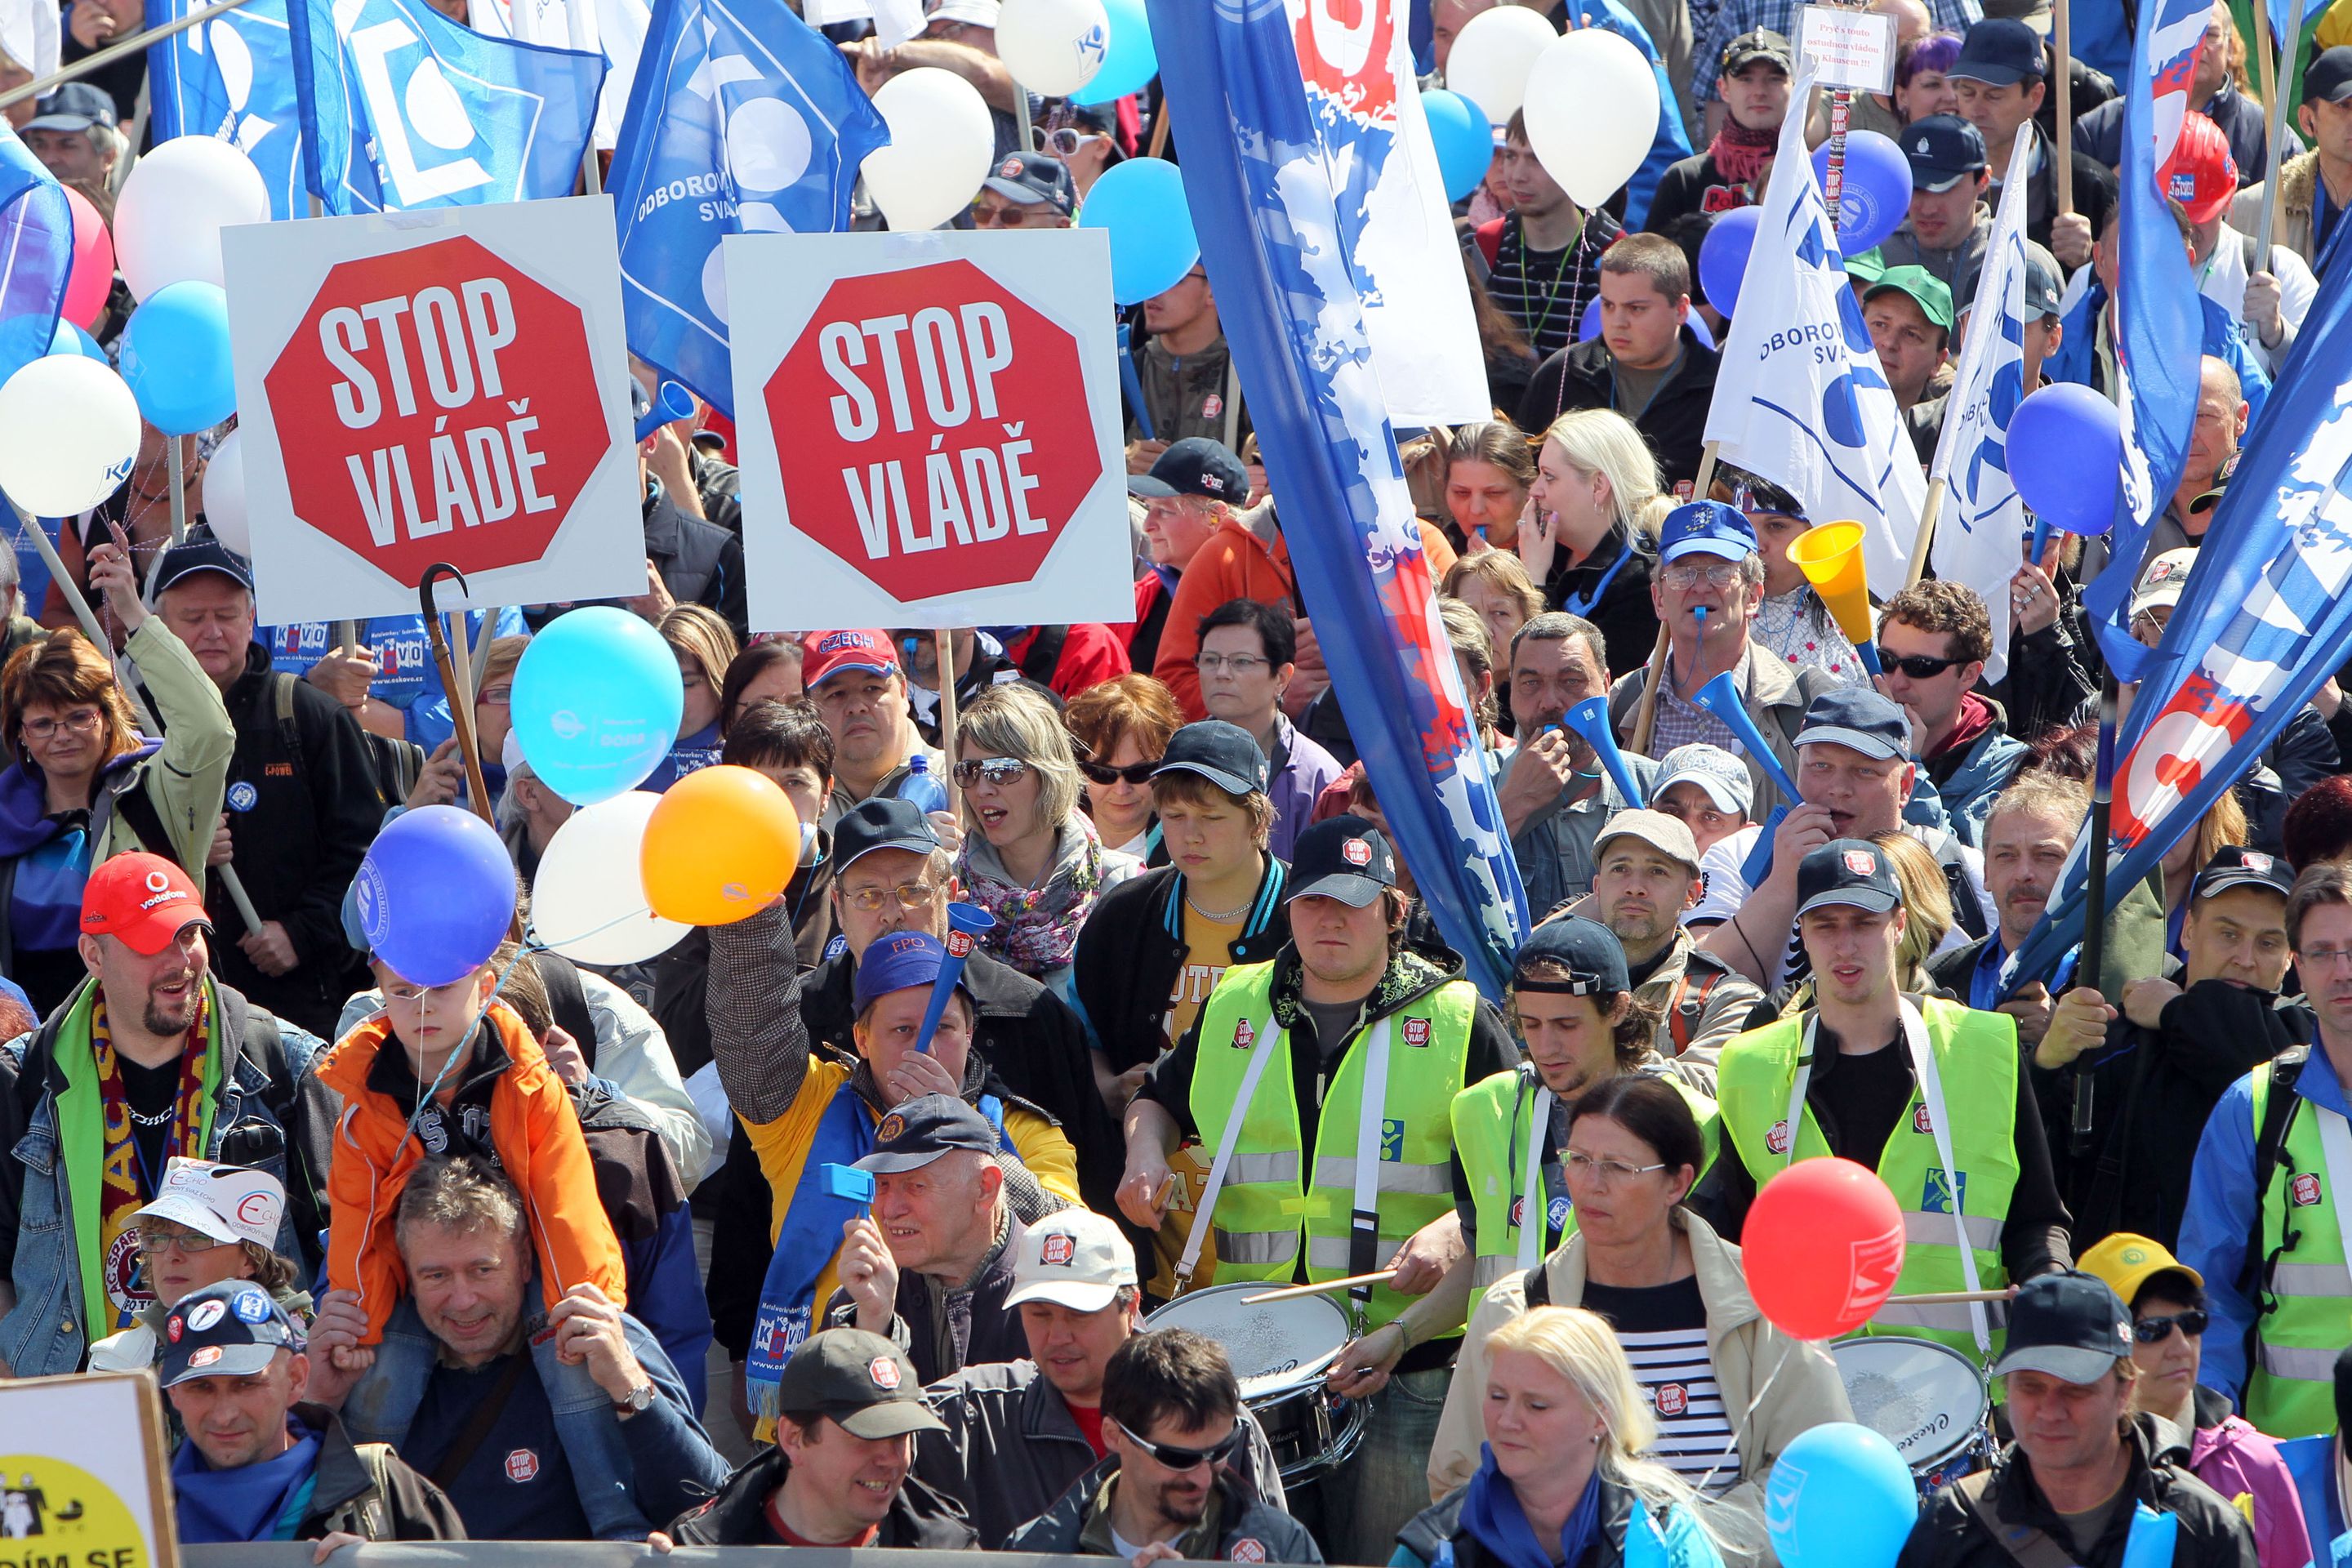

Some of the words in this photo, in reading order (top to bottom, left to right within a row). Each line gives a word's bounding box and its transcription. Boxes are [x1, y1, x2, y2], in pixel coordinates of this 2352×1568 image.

[1820, 23, 1839, 34] Pryč
[1847, 28, 1870, 38] touto
[1807, 38, 1848, 49] ostudnou
[1851, 43, 1880, 54] vládou
[1822, 54, 1858, 66] Klausem
[639, 170, 733, 223] ODBOROV
[699, 196, 738, 221] SVA
[318, 276, 516, 430] STOP
[818, 301, 1013, 443] STOP
[346, 397, 557, 548] VLÁDĚ
[842, 421, 1049, 560] VLÁDĚ
[819, 632, 875, 653] CZECH
[373, 645, 421, 670] KOVO
[371, 677, 423, 685] www.oskovo.cz
[1348, 842, 1365, 853] STOP
[140, 889, 188, 911] vodafone
[892, 938, 925, 952] FPO
[1409, 1022, 1425, 1033] STOP
[199, 1191, 216, 1204] ECHO
[1049, 1239, 1067, 1250] STOP
[751, 1361, 786, 1370] www.osk
[1662, 1388, 1680, 1402] STOP
[1897, 1413, 1949, 1452] Cheste
[510, 1454, 530, 1468] STOP
